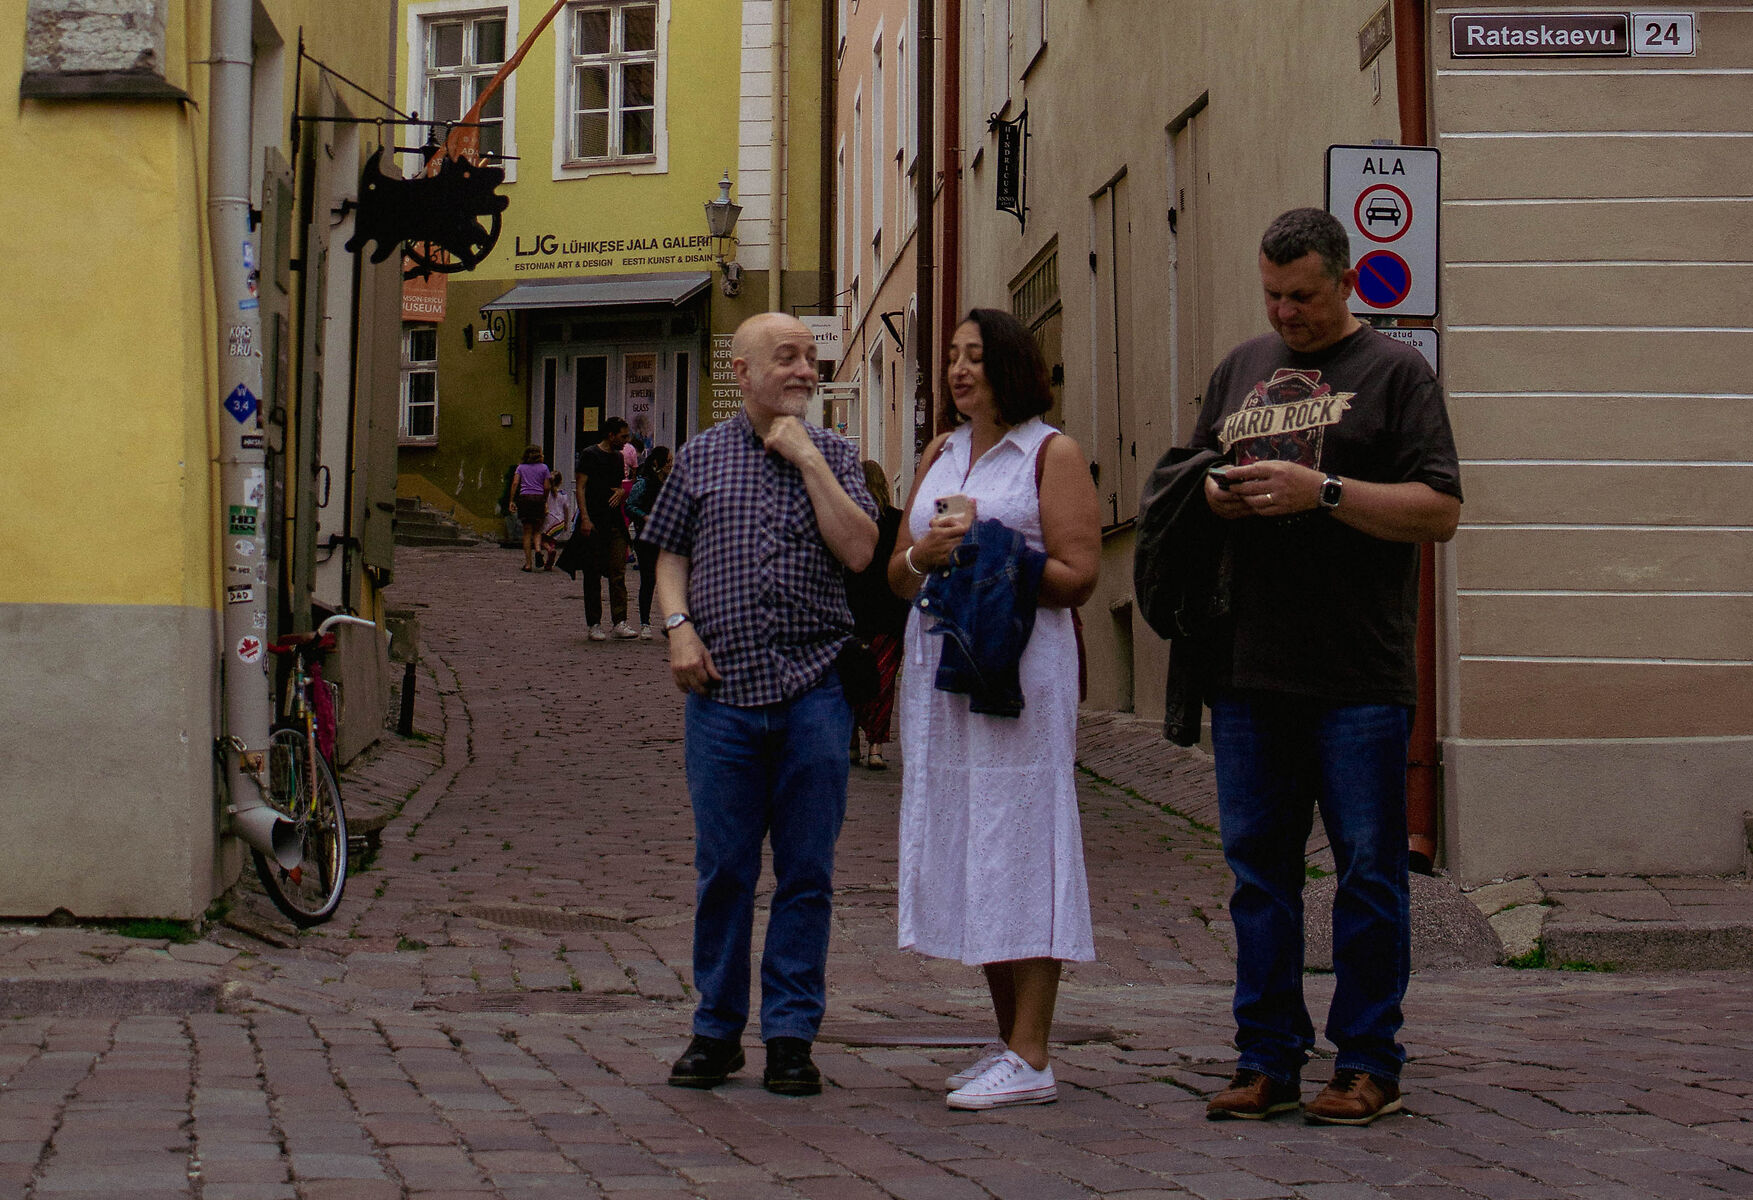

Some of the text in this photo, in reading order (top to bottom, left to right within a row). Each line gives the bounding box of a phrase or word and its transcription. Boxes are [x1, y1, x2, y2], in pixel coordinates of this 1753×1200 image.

[1467, 25, 1615, 46] Rataskaevu
[1645, 22, 1680, 46] 24
[1362, 157, 1405, 175] ALA
[562, 240, 624, 254] LÜHIKESE
[626, 237, 659, 250] JALA
[515, 253, 712, 271] ESTONIAN ART & DESIGN EESTI KUNST & DISAIN
[814, 332, 838, 341] rtile
[713, 339, 734, 348] TEK
[713, 350, 732, 358] KER
[713, 361, 734, 369] KLA
[713, 371, 737, 380] EHTE
[712, 389, 744, 397] TEXTIL
[712, 411, 740, 419] GLAS
[1226, 399, 1335, 442] HARD ROCK
